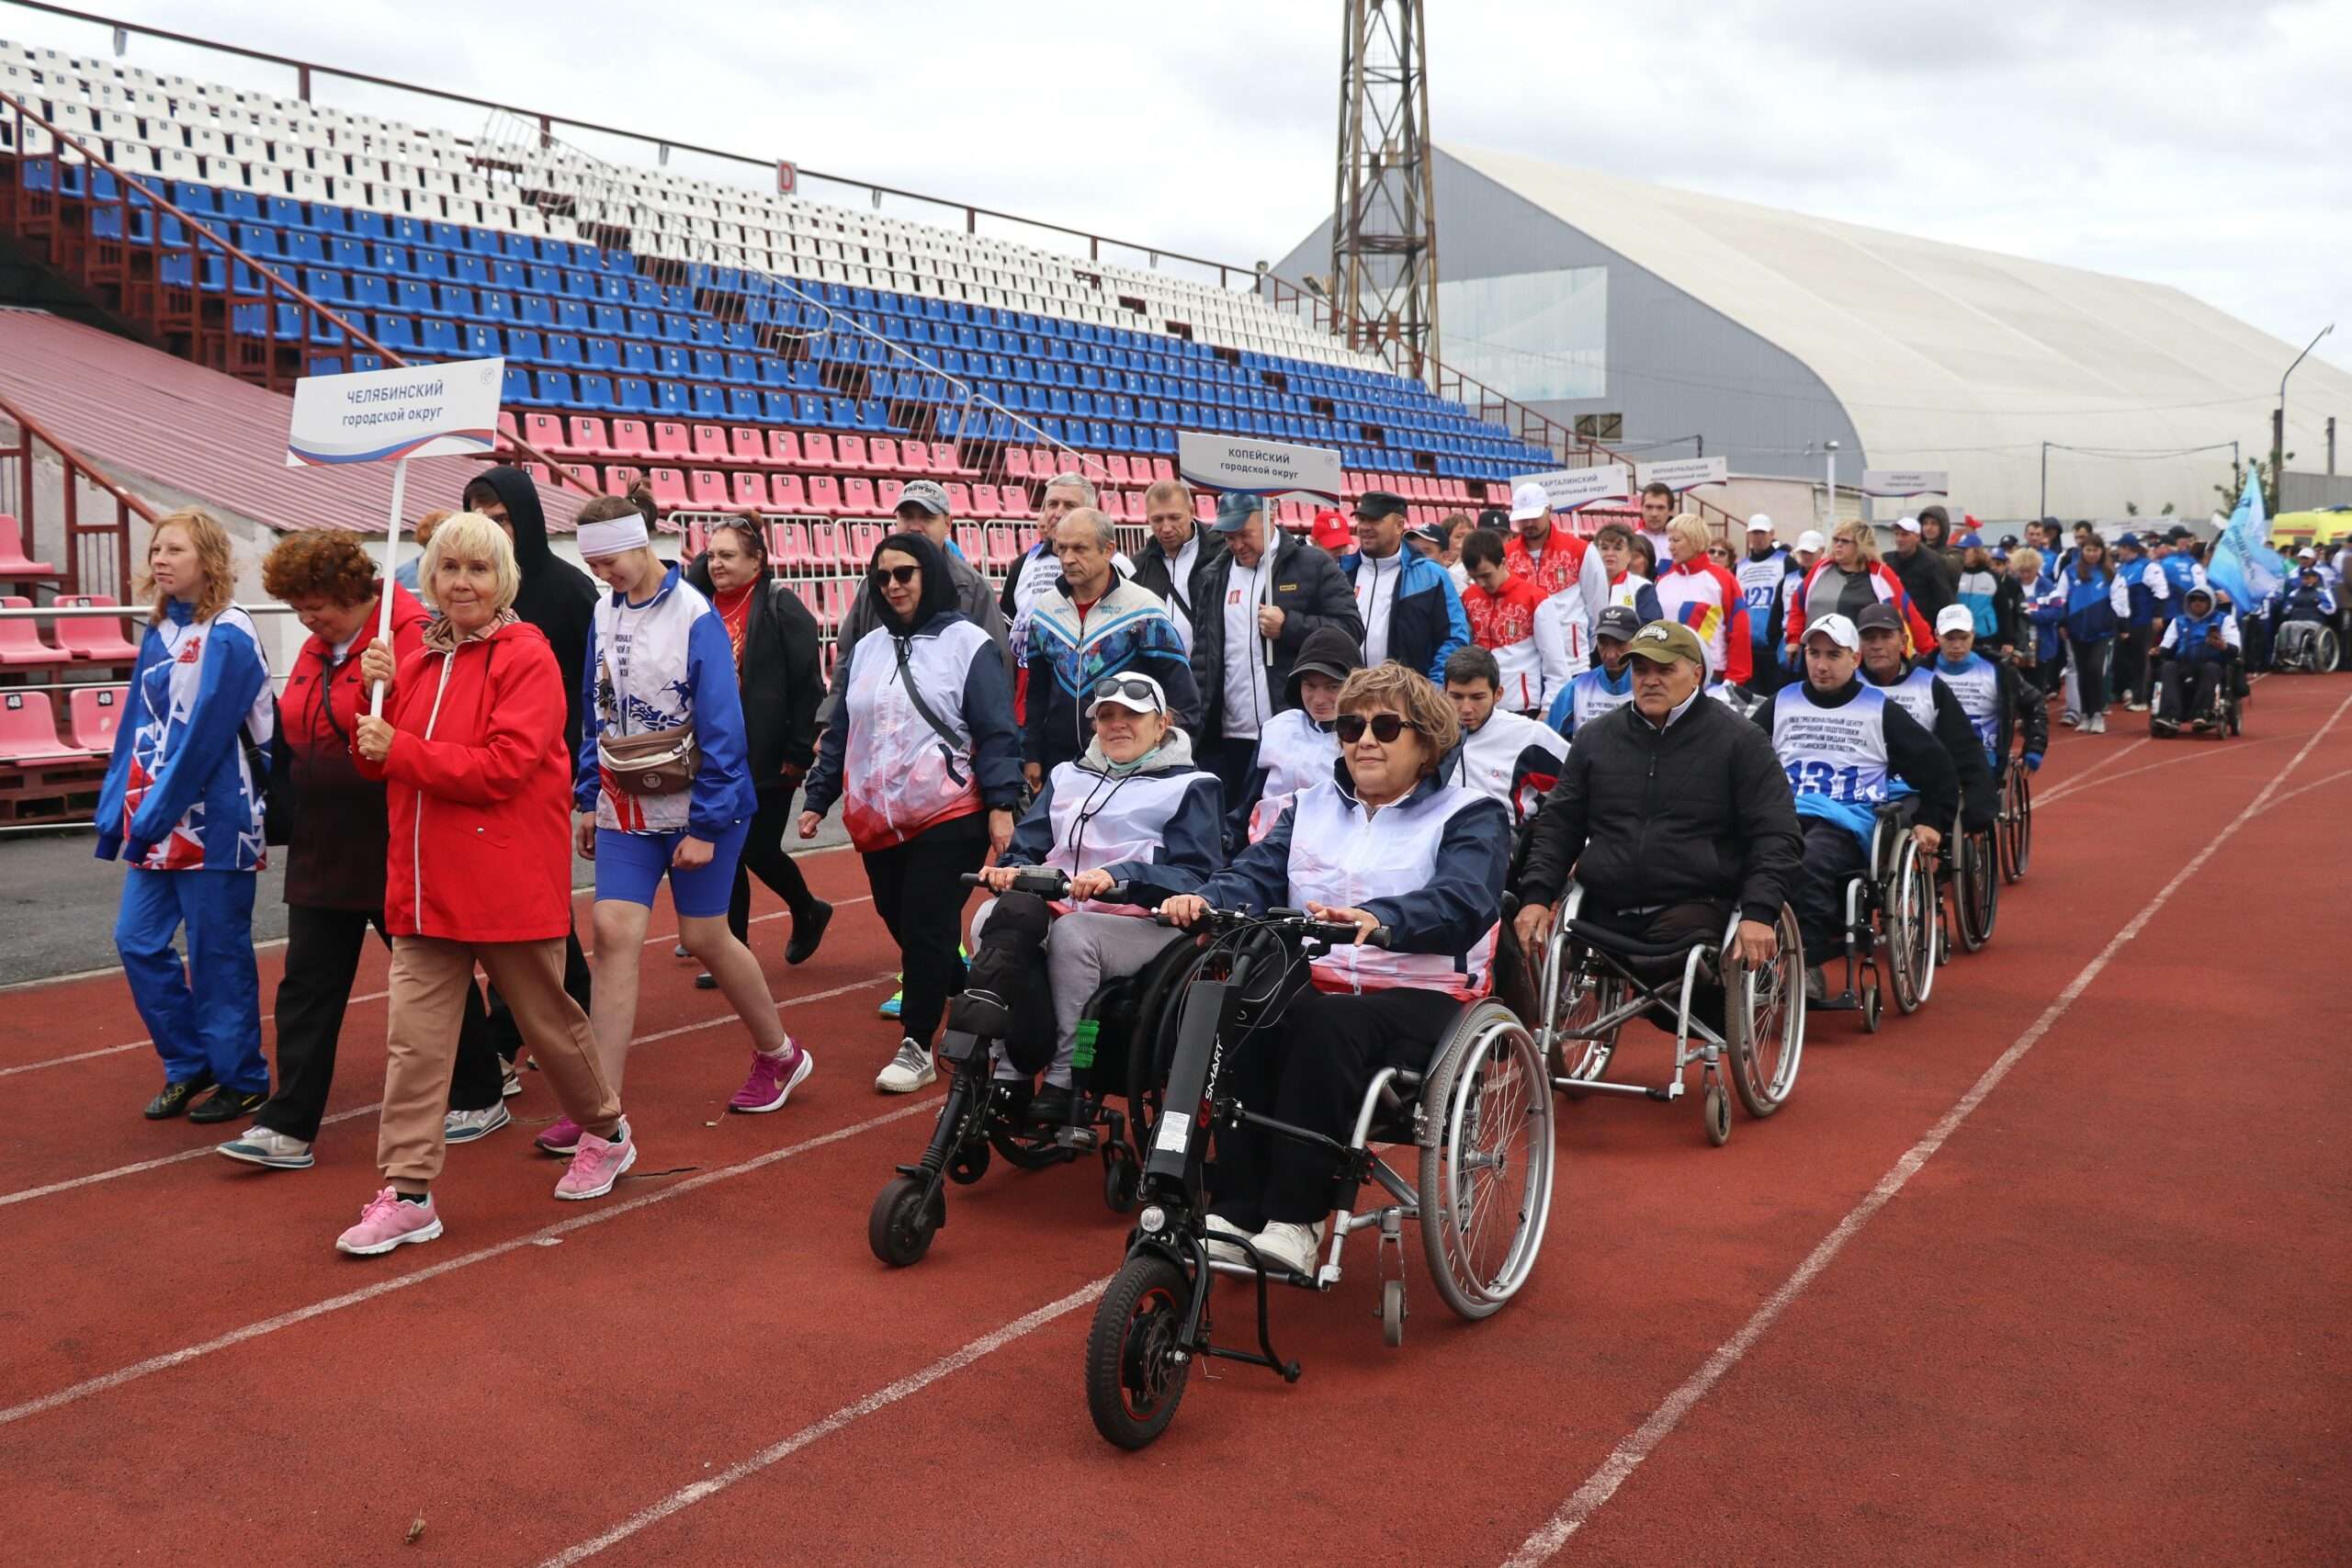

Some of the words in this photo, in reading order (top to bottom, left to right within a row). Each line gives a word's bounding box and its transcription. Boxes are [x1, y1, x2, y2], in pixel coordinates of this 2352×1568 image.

[780, 162, 794, 190] D
[346, 379, 444, 404] ЧЕЛЯБИНСКИЙ
[343, 407, 405, 427] городской
[408, 405, 444, 423] округ
[1228, 448, 1290, 464] КОПЕЙСКИЙ
[1220, 462, 1270, 475] городской
[1272, 469, 1298, 479] округ
[1539, 475, 1598, 488] КАРТАЛИНСКИЙ
[1546, 487, 1588, 497] ципальный
[7, 695, 21, 707] 48
[98, 693, 112, 705] 49
[1848, 738, 1867, 746] СПОРТА
[1784, 761, 1859, 801] 131
[1205, 1039, 1224, 1101] SMART
